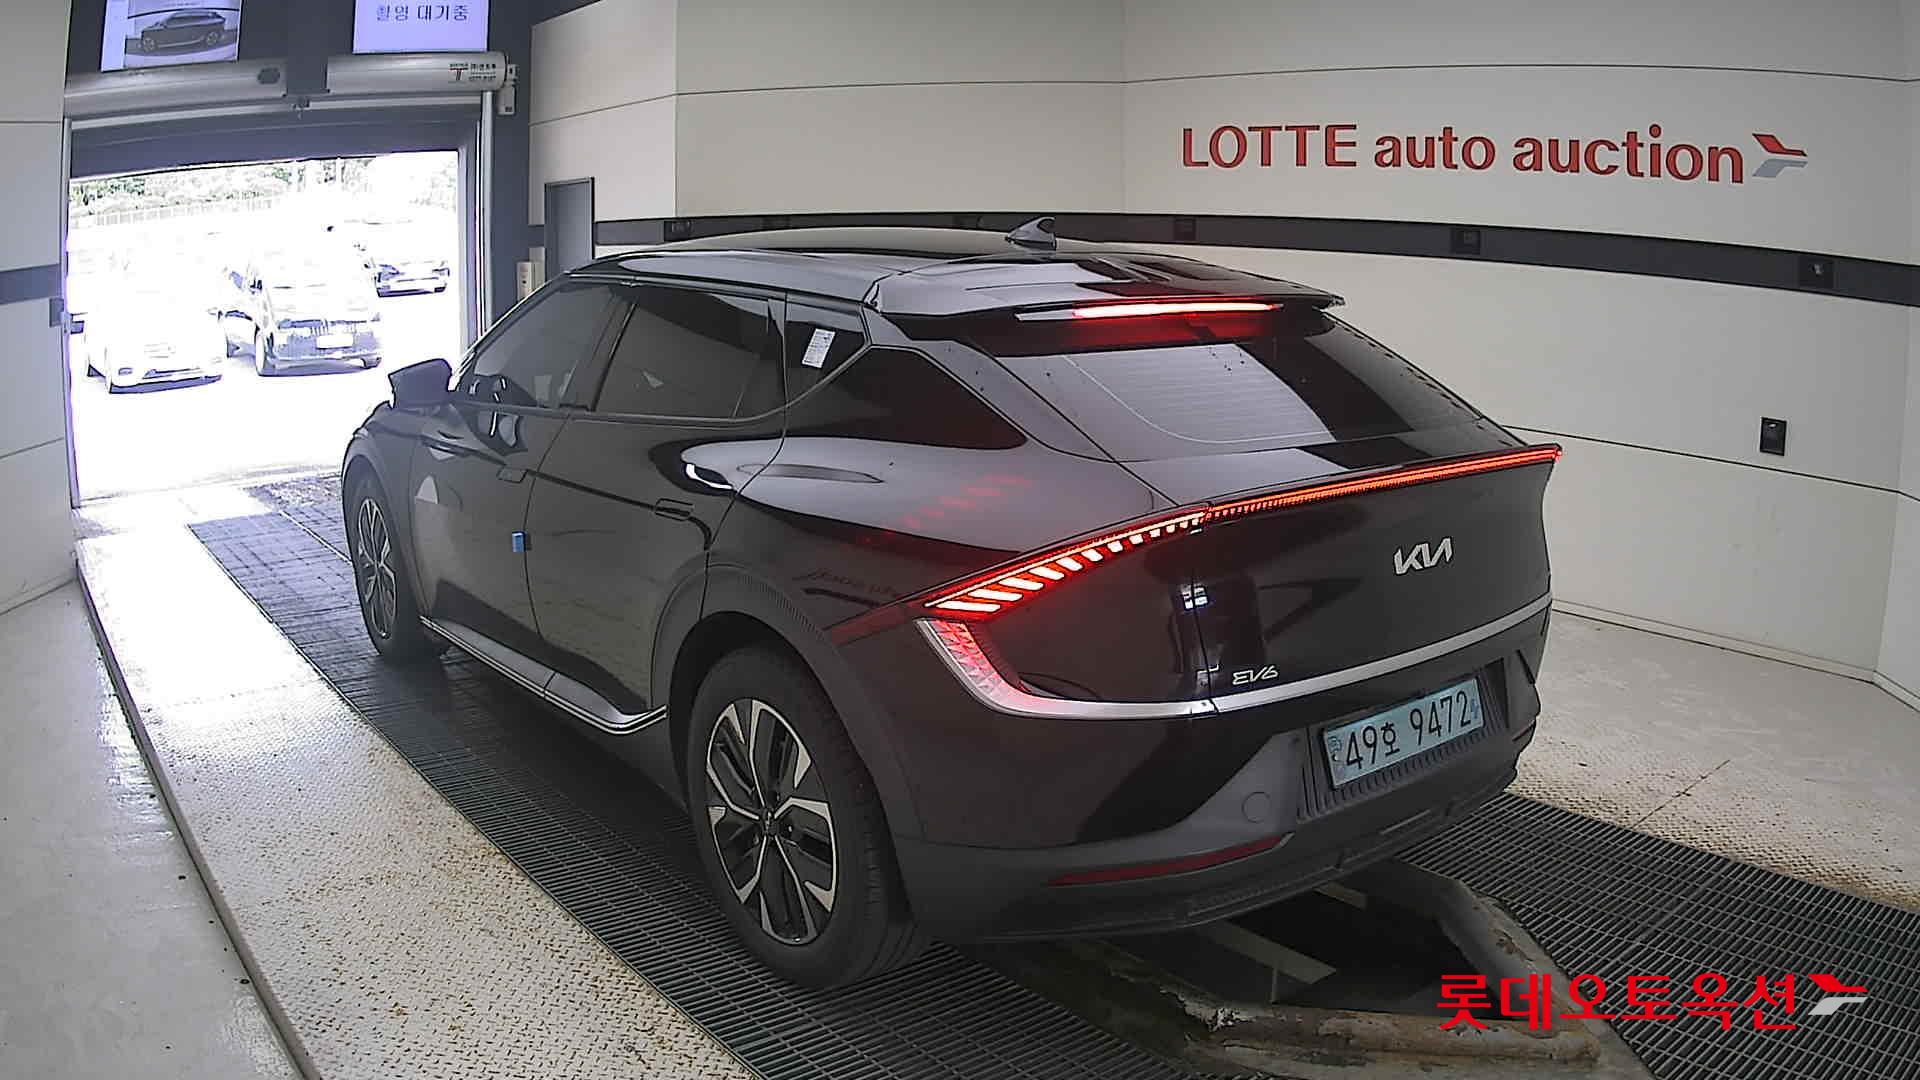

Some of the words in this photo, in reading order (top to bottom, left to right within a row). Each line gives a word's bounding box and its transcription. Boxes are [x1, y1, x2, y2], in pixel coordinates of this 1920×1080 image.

[417, 5, 469, 21] 대기중
[1182, 124, 1357, 168] LOTTE
[1374, 126, 1496, 170] auto
[1512, 124, 1744, 184] auction
[1232, 665, 1279, 685] EV6
[1346, 721, 1401, 770] 49호
[1409, 690, 1472, 746] 9472
